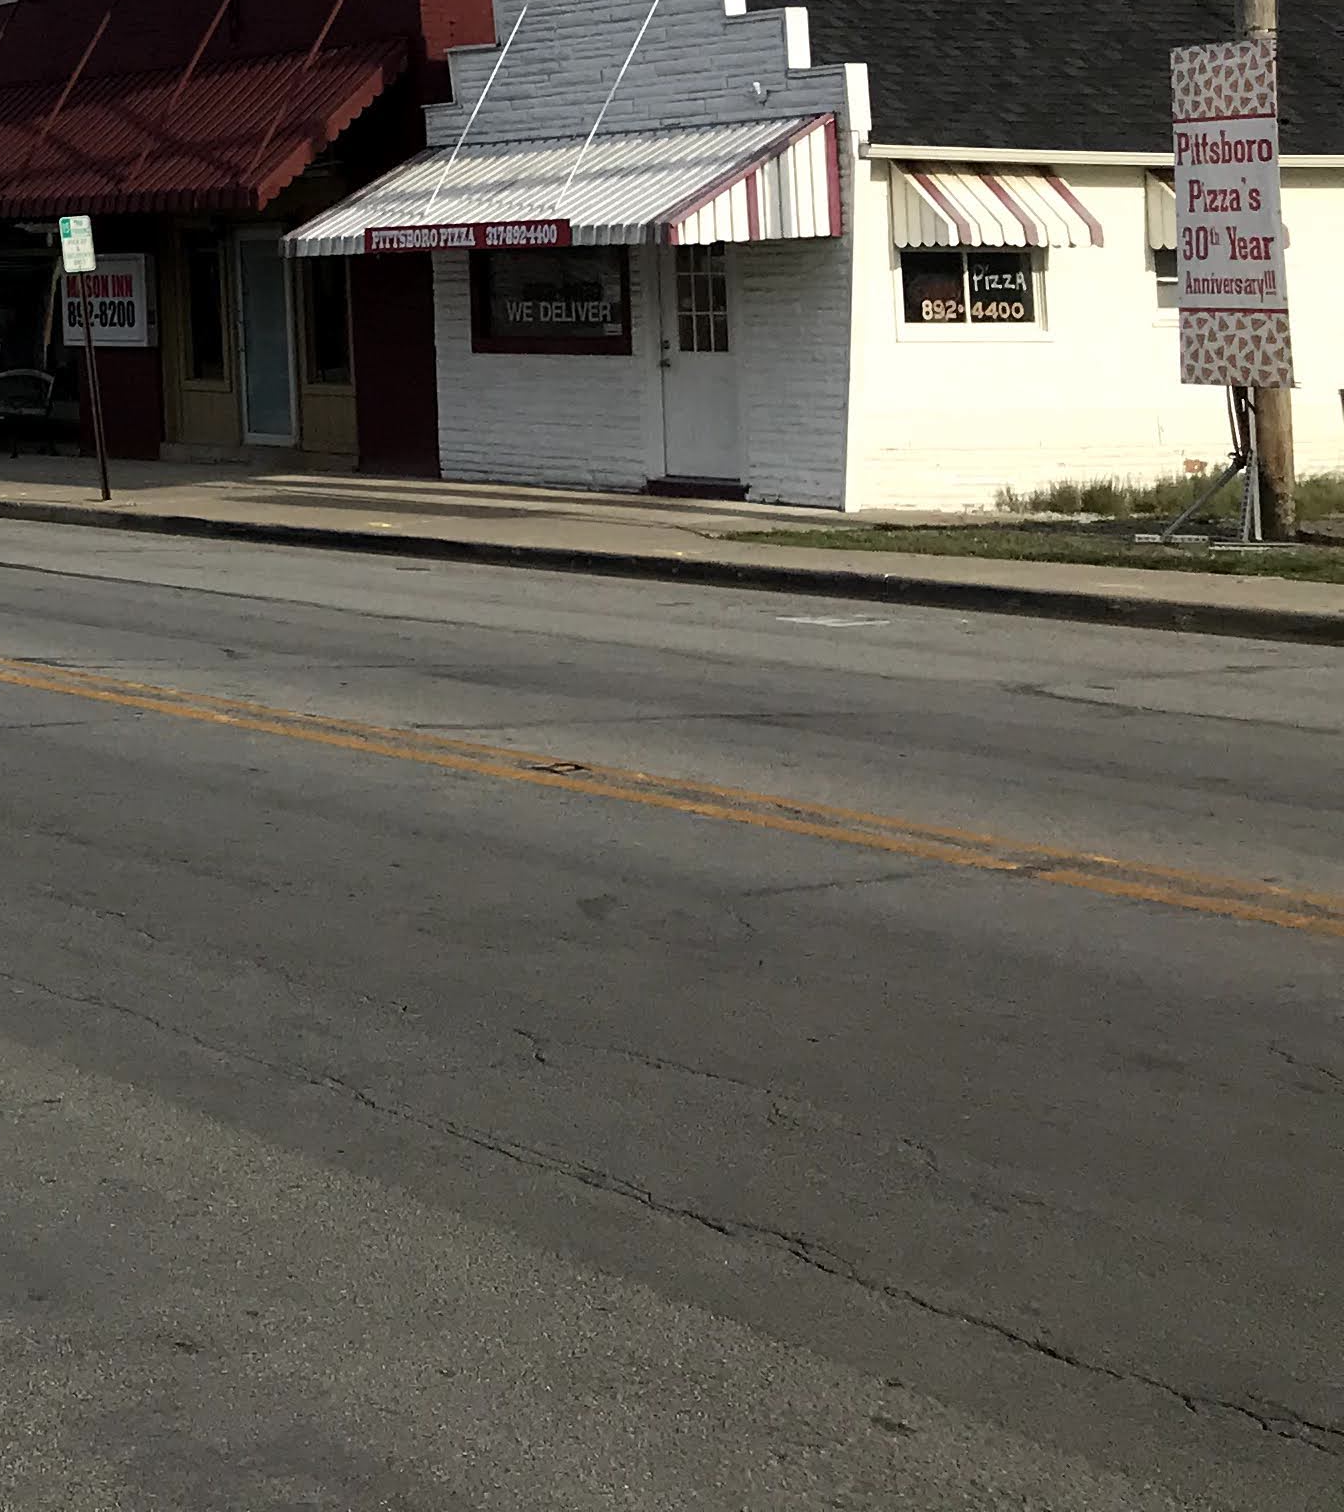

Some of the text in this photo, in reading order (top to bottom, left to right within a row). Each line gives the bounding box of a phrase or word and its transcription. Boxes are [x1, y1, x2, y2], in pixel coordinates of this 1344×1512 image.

[1176, 130, 1273, 166] Pittsboro
[1188, 177, 1261, 213] Pizza's
[371, 224, 557, 249] PITTSBORO PIZZA 317-892-4400
[1182, 225, 1275, 261] 30th Year
[66, 274, 133, 298] MSON INN
[1185, 270, 1277, 303] Anniversary!!!
[506, 301, 612, 322] WE DELIVER
